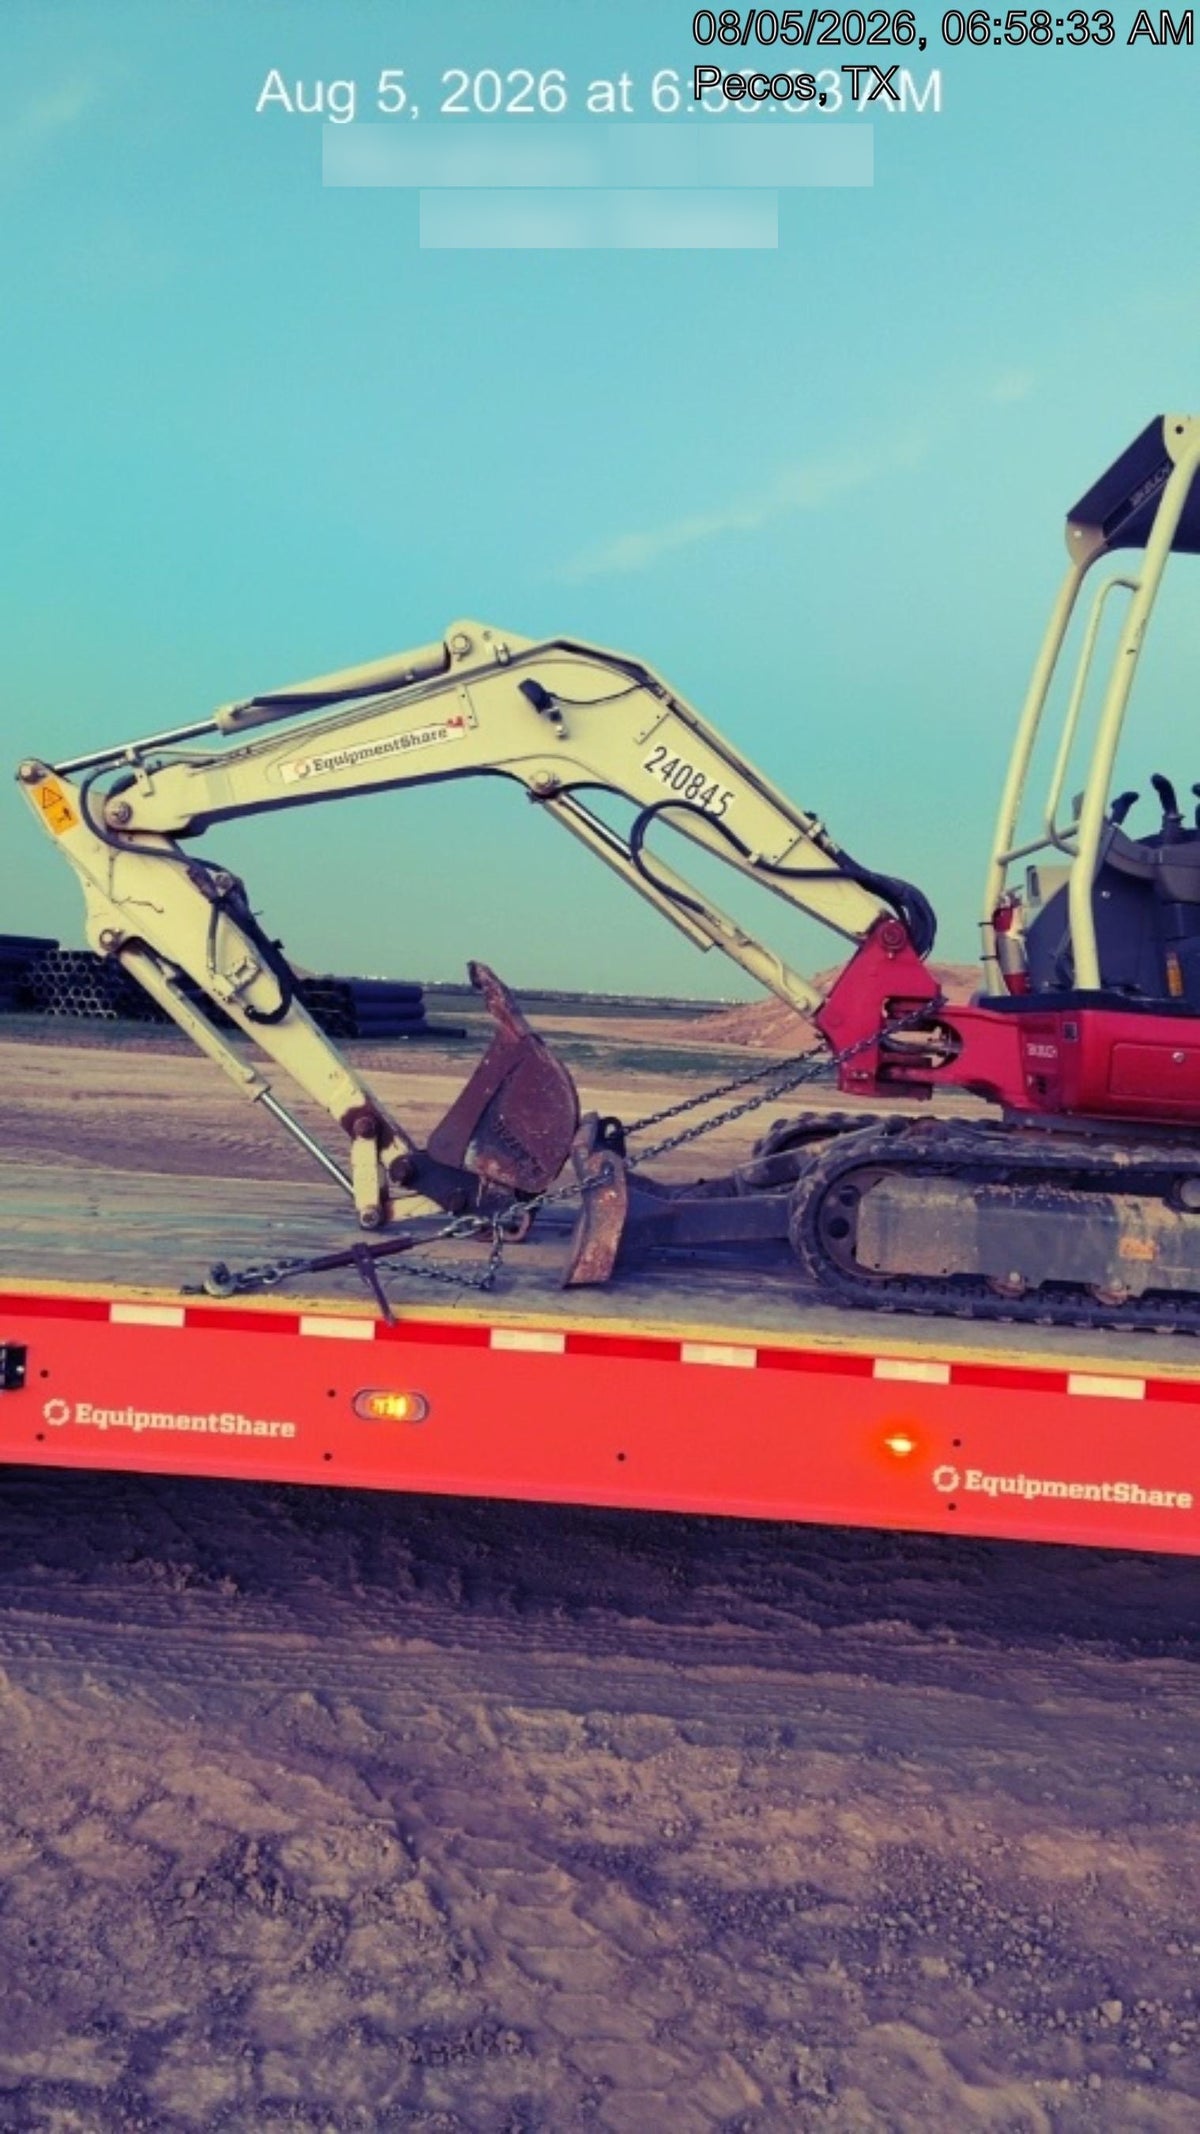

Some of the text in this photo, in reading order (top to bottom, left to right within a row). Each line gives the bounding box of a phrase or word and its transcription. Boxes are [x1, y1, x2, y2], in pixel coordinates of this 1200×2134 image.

[312, 729, 448, 772] EquipmentShare
[643, 745, 736, 818] 240845
[74, 1402, 296, 1439] EquipmentShare
[964, 1468, 1194, 1510] EquipmentShare
